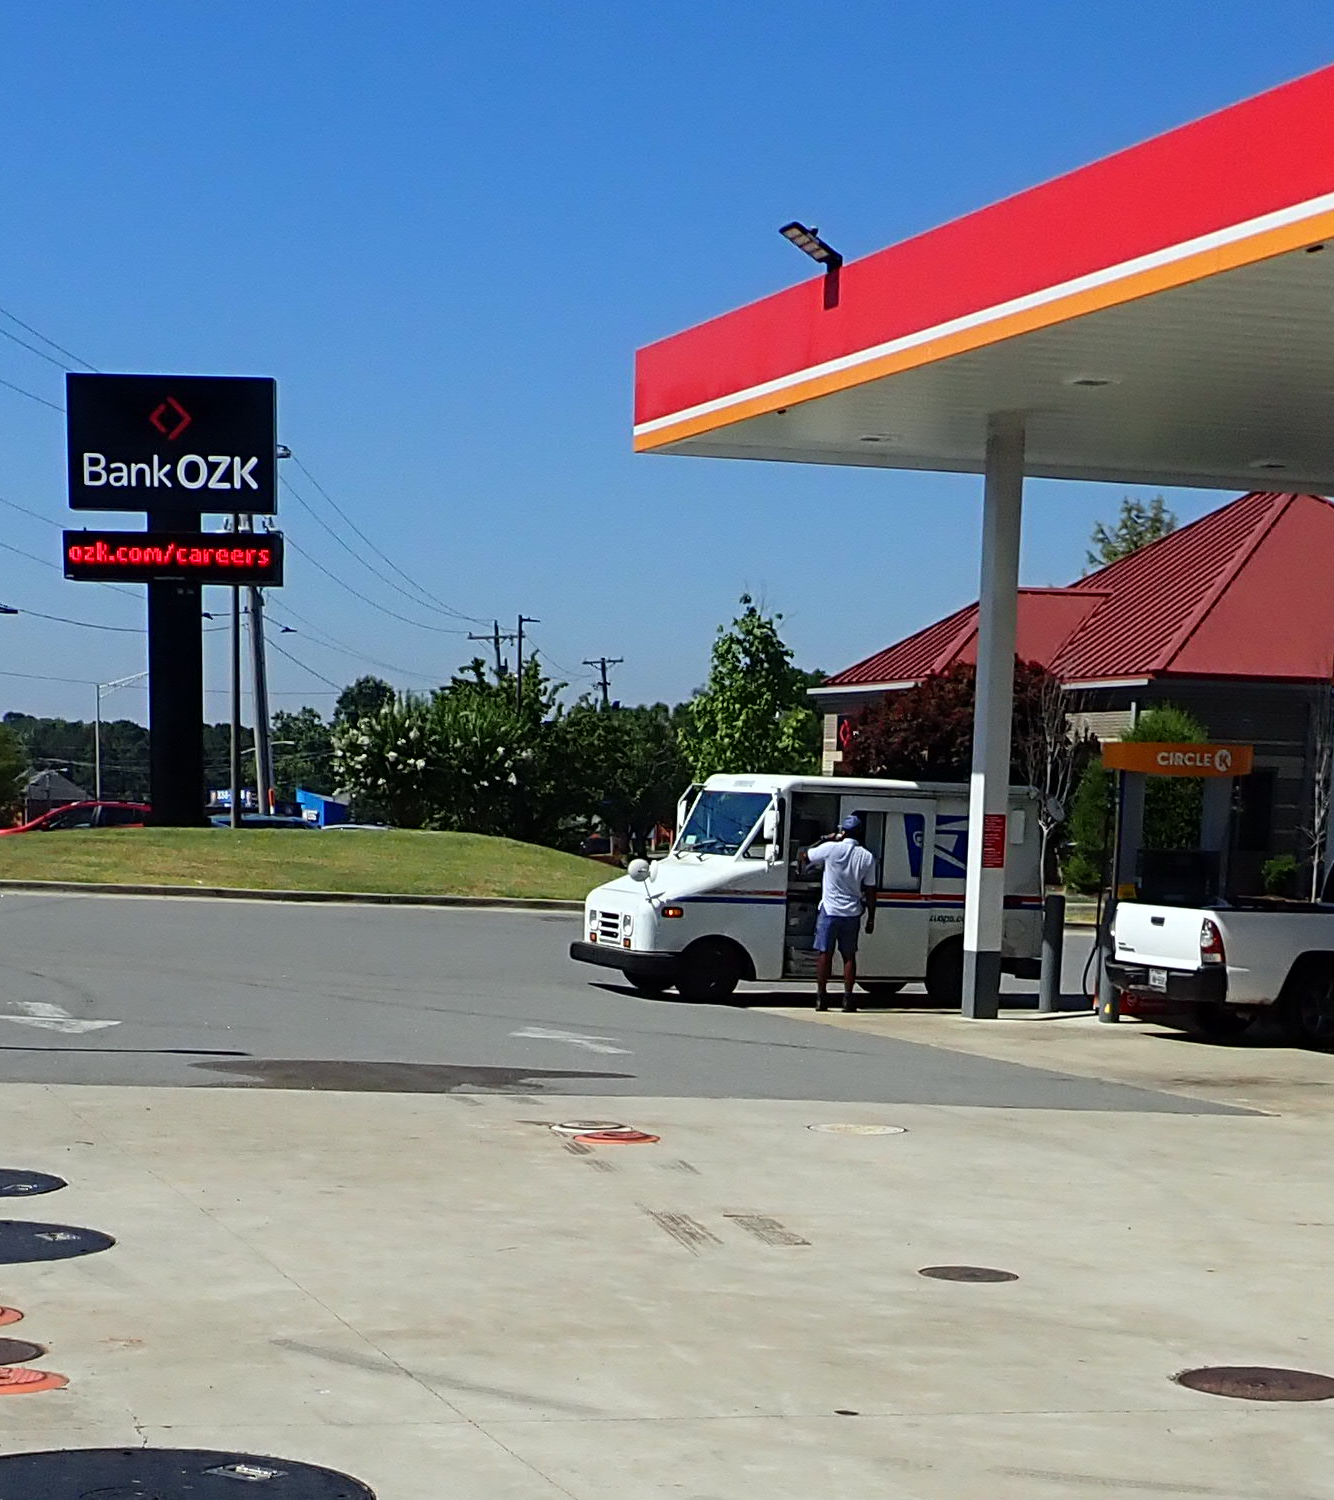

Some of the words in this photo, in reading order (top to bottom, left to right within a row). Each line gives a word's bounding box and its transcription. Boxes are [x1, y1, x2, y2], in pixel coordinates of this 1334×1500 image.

[83, 453, 172, 488] Bank
[176, 455, 259, 490] OZK
[68, 542, 269, 566] ozk.com/careers
[1157, 752, 1212, 766] CIRCLE
[1214, 749, 1232, 772] K
